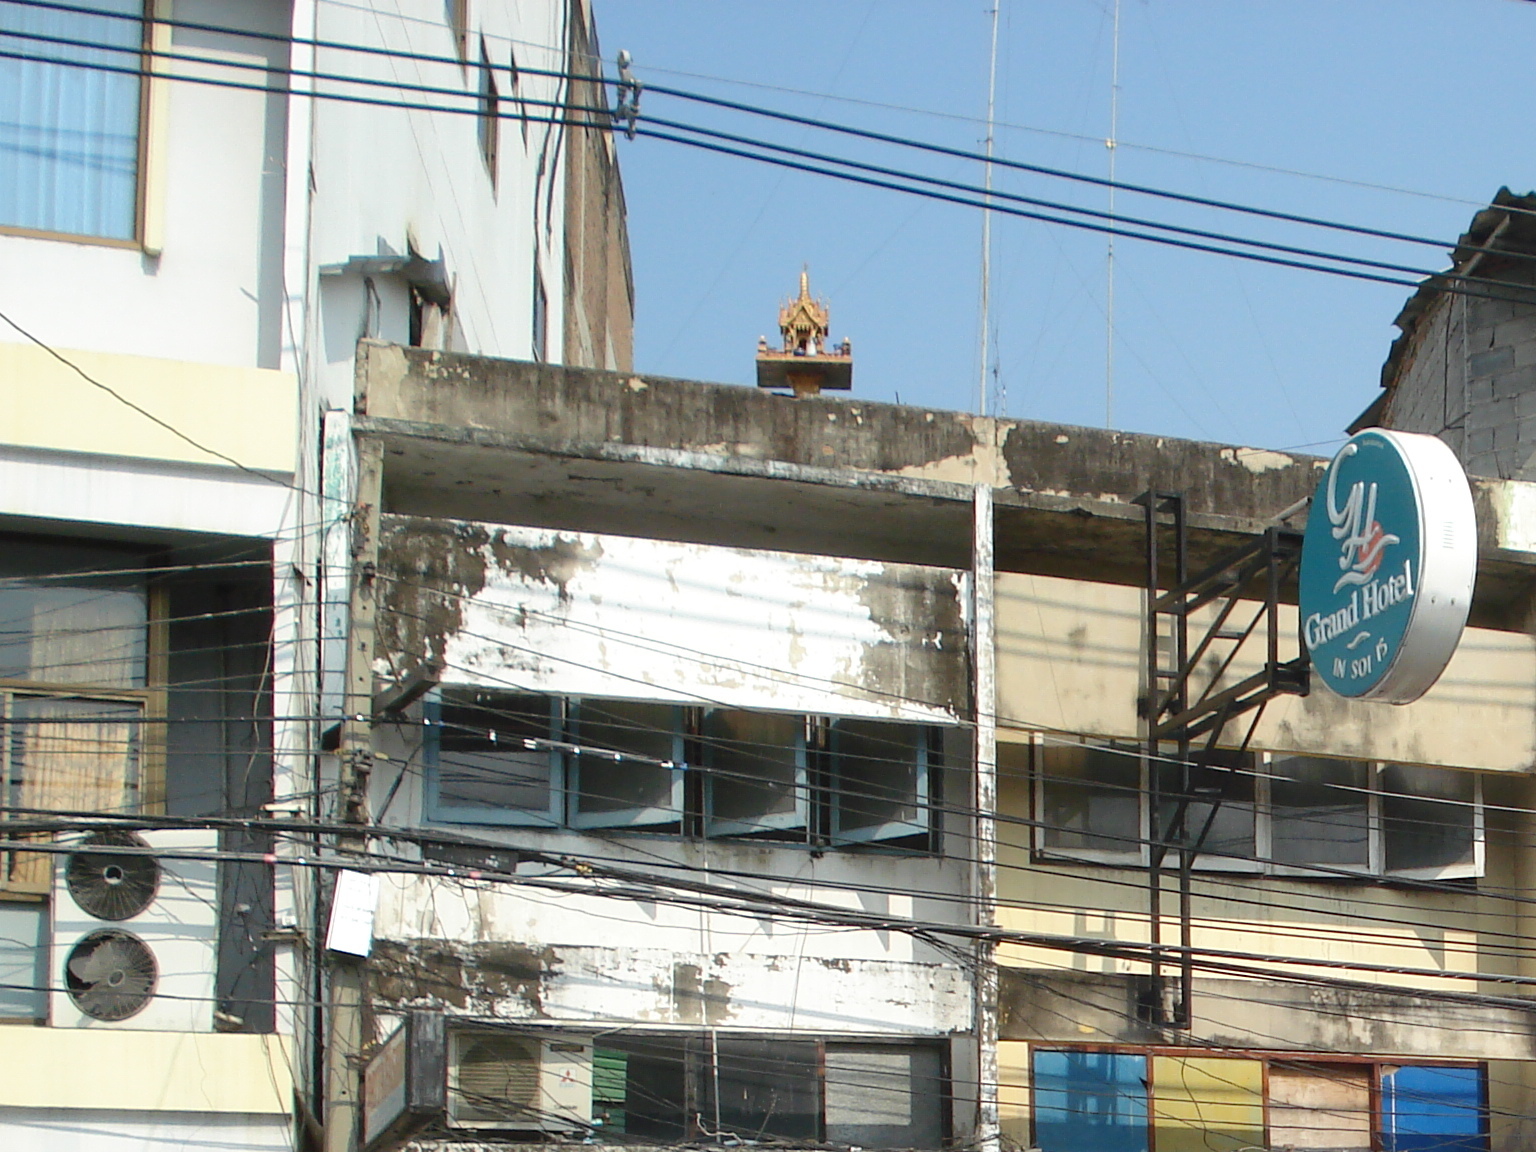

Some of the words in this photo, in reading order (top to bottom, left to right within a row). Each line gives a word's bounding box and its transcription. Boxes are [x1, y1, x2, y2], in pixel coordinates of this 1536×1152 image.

[1304, 590, 1358, 651] Grand
[1362, 559, 1415, 621] Hotel
[1332, 657, 1346, 679] IN
[1351, 654, 1372, 679] SOI
